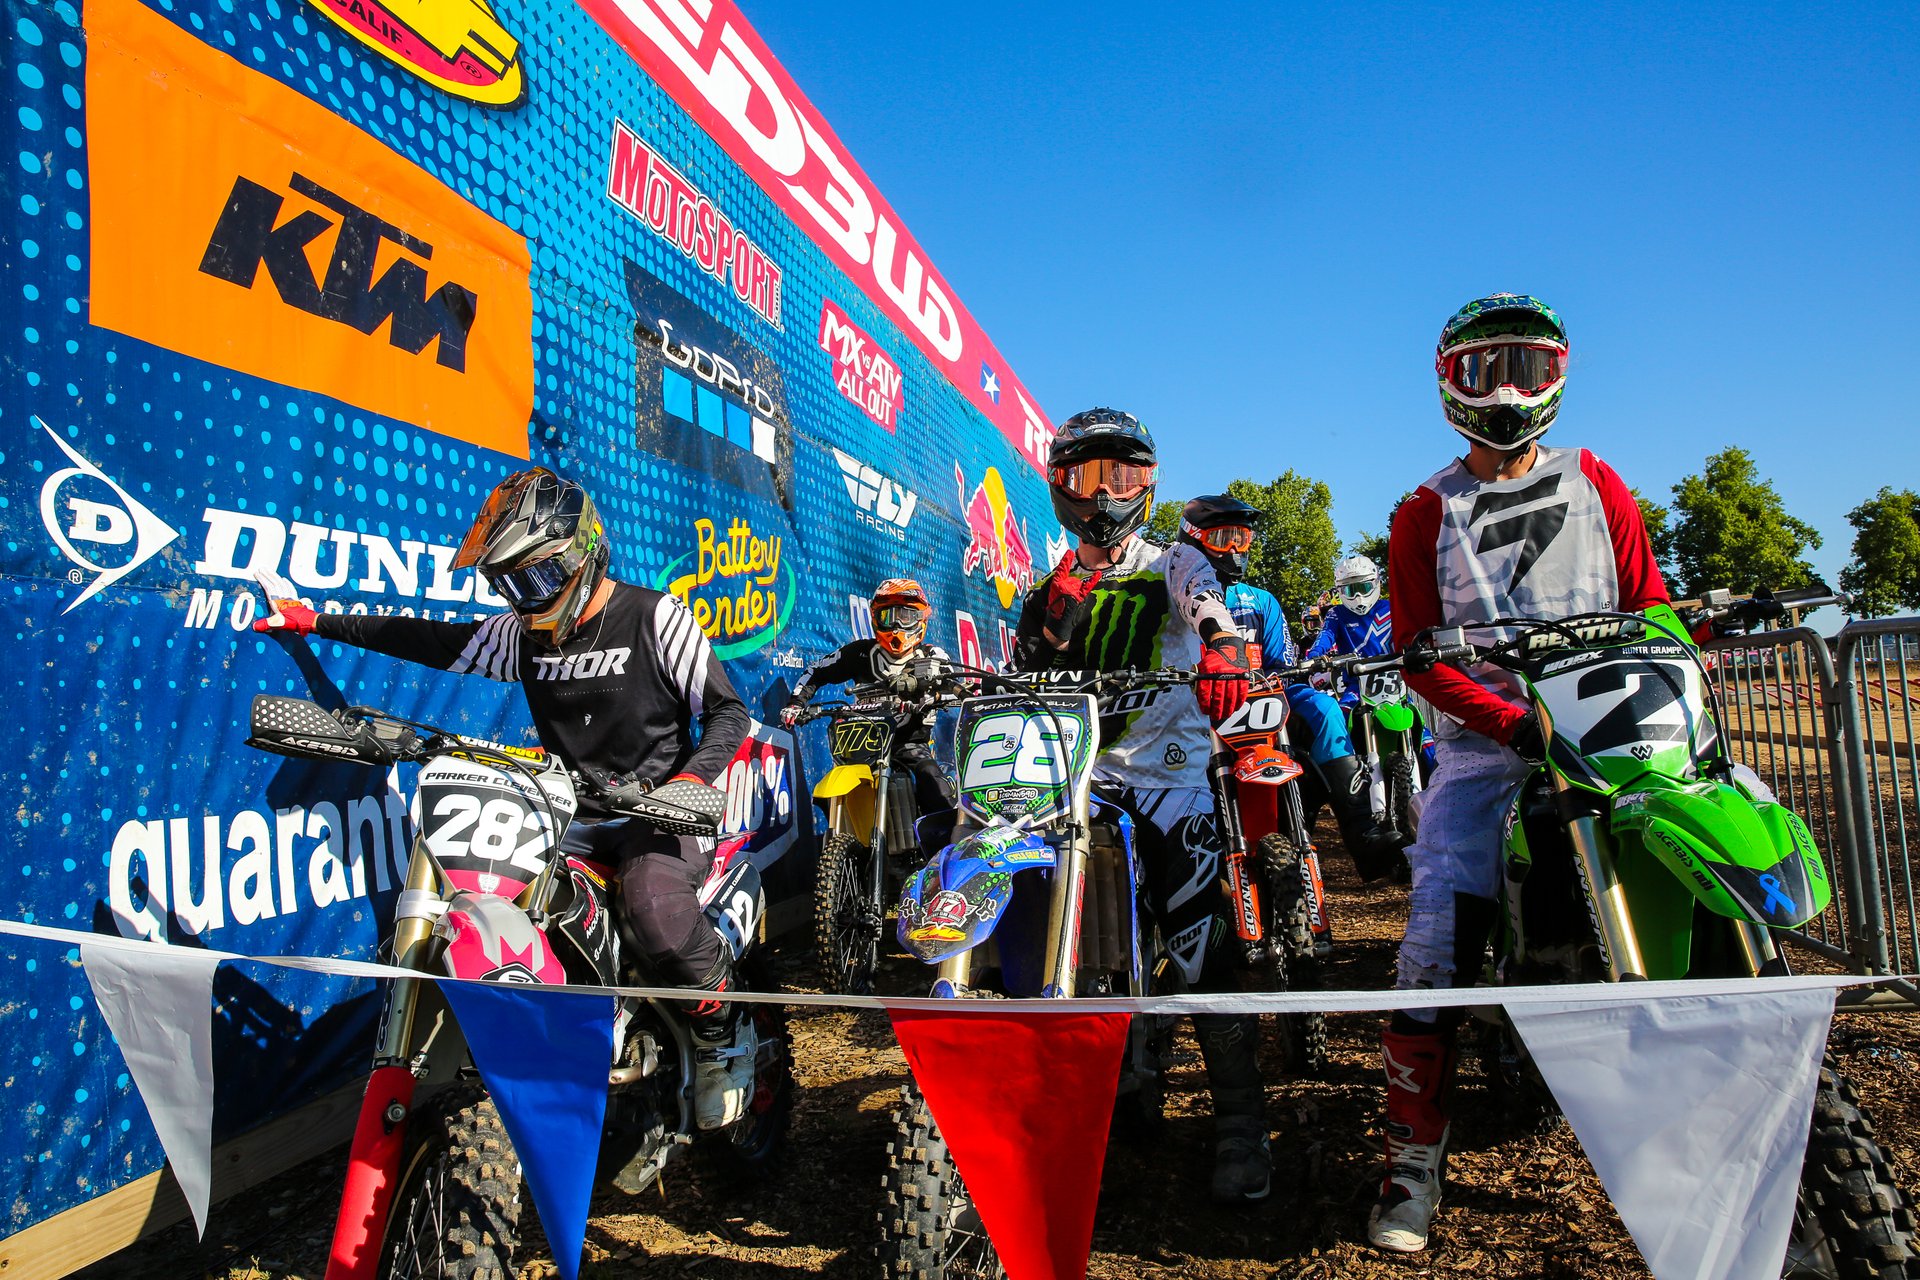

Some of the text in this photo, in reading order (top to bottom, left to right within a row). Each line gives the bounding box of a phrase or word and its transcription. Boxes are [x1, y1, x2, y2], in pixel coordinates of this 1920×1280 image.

[198, 172, 477, 374] KTM
[820, 308, 866, 378] MX
[865, 352, 902, 400] ATV
[836, 368, 892, 426] ALL OUT
[832, 446, 918, 528] FLY
[694, 517, 781, 586] Battery
[855, 509, 905, 542] RACING
[668, 579, 778, 645] Tender
[532, 645, 632, 682] THOR
[1650, 646, 1682, 655] GRAMPP
[834, 721, 890, 756] 779
[1215, 697, 1283, 736] 20
[1576, 661, 1687, 759] 2
[960, 711, 1085, 793] 28
[1004, 740, 1016, 750] 25
[425, 772, 489, 783] PARKER
[426, 793, 563, 877] 282
[1169, 920, 1208, 951] thor
